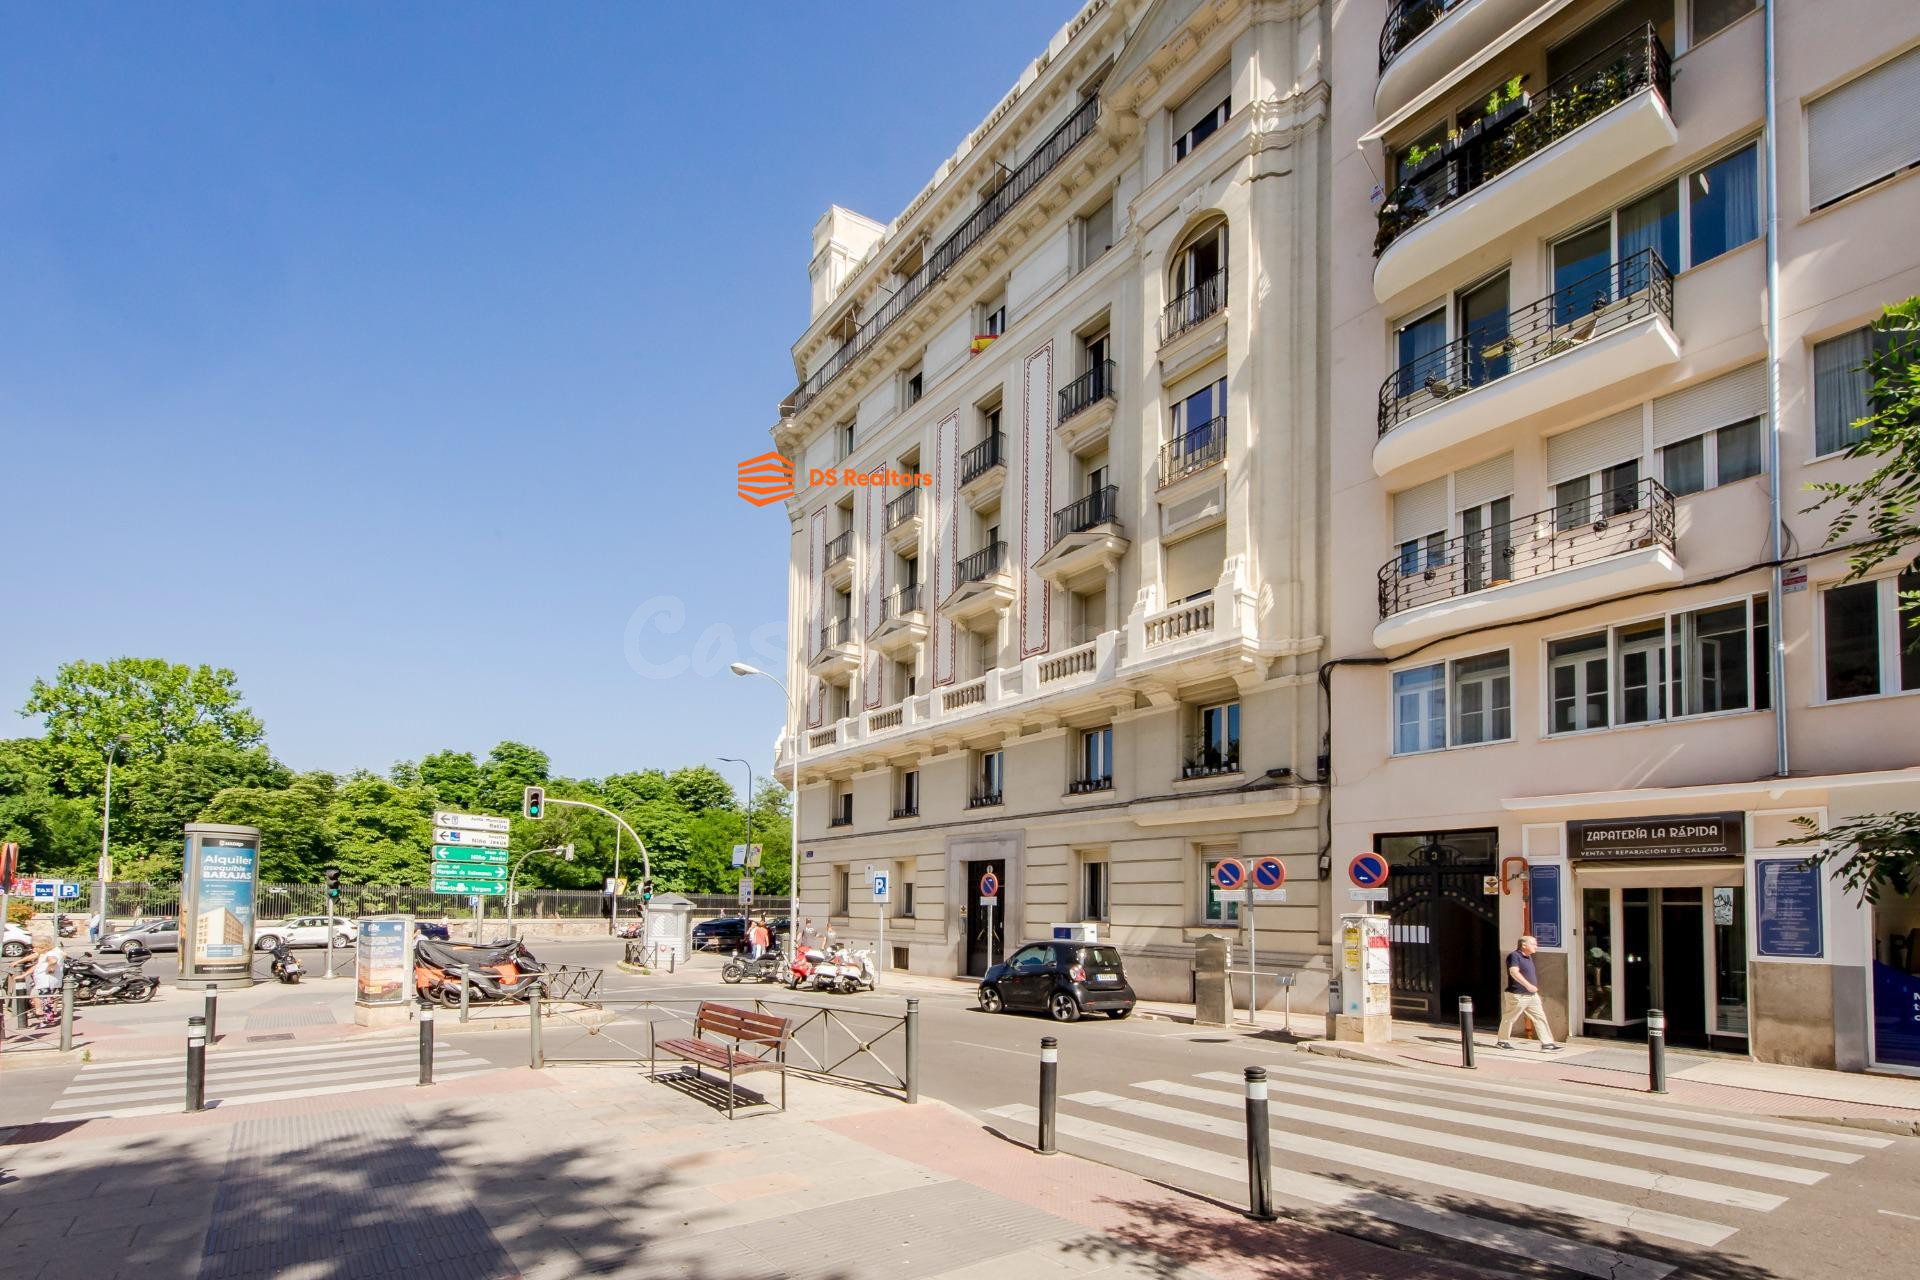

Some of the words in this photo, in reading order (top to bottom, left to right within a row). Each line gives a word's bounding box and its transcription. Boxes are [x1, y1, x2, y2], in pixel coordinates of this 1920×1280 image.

[1586, 827, 1648, 842] ZAPATERÍA
[1651, 828, 1666, 839] LA
[1669, 825, 1718, 838] RÁPIDA
[204, 855, 252, 865] Alquiler
[203, 871, 252, 879] BARAJAS
[63, 886, 74, 895] P
[876, 879, 884, 893] P
